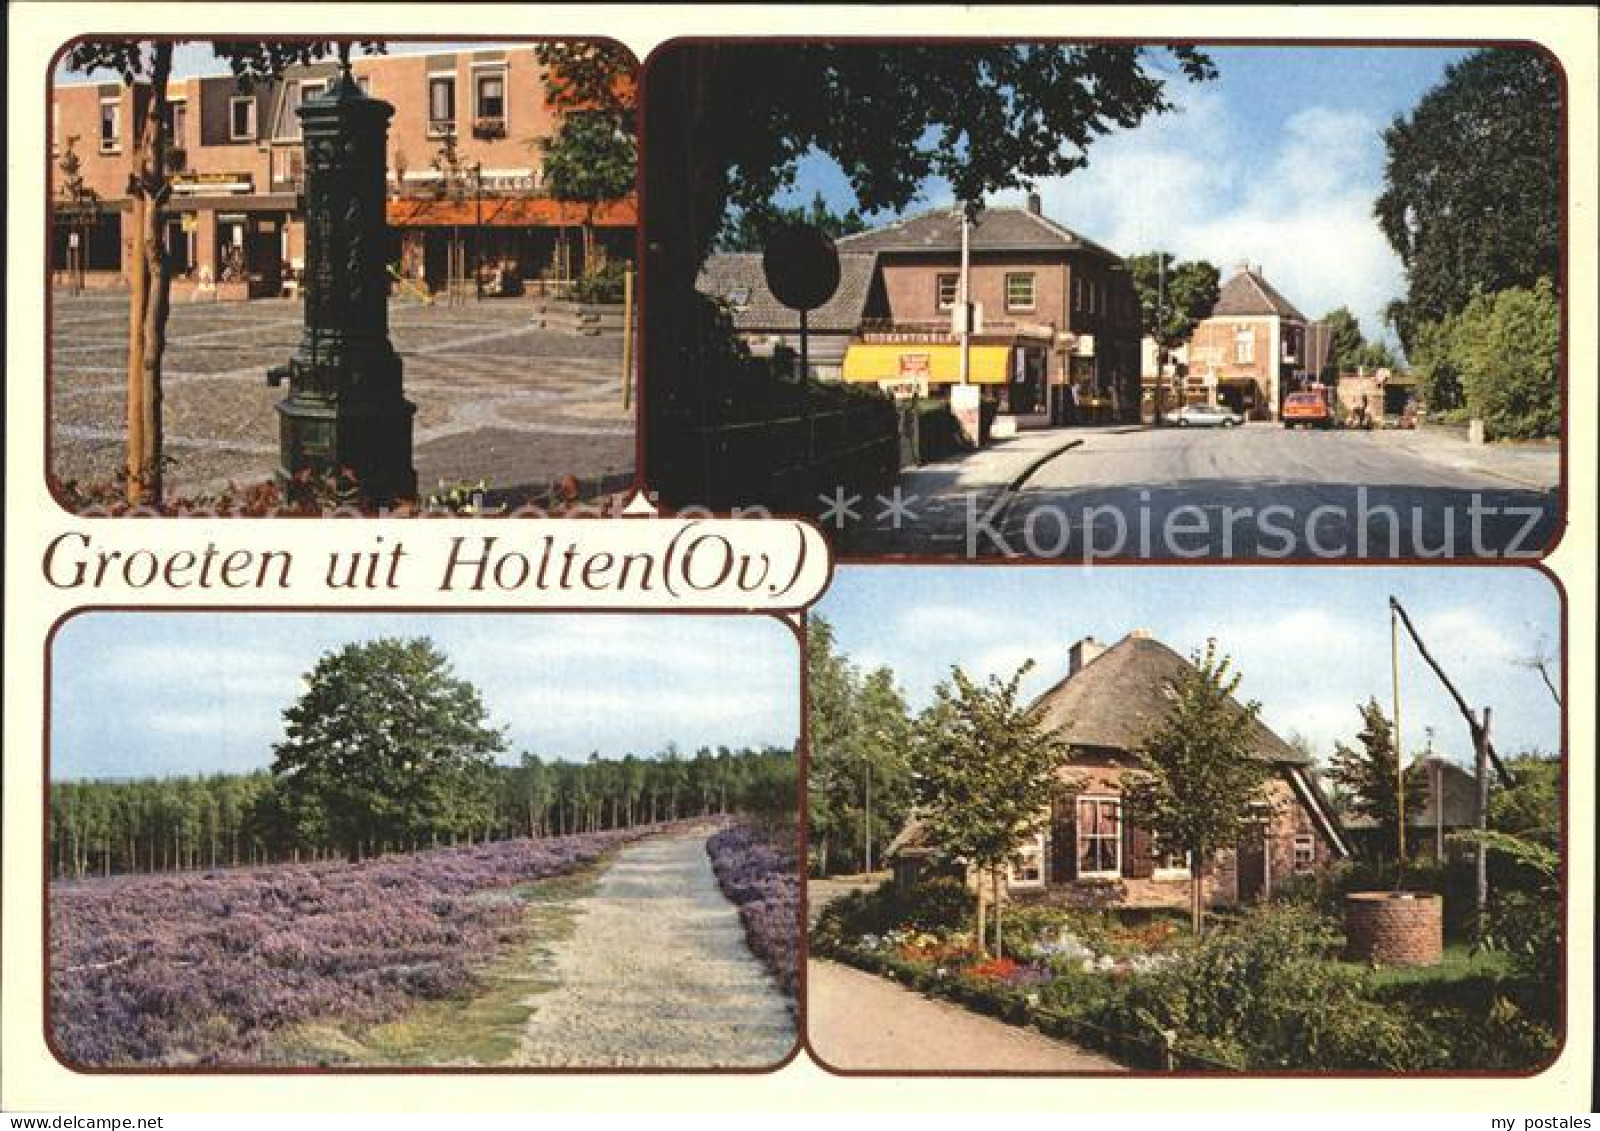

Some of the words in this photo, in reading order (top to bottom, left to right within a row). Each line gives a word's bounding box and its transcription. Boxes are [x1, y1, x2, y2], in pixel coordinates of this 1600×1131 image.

[43, 532, 292, 588] Groeten
[327, 537, 404, 588] uit
[439, 521, 807, 598] Holten(Ov.)
